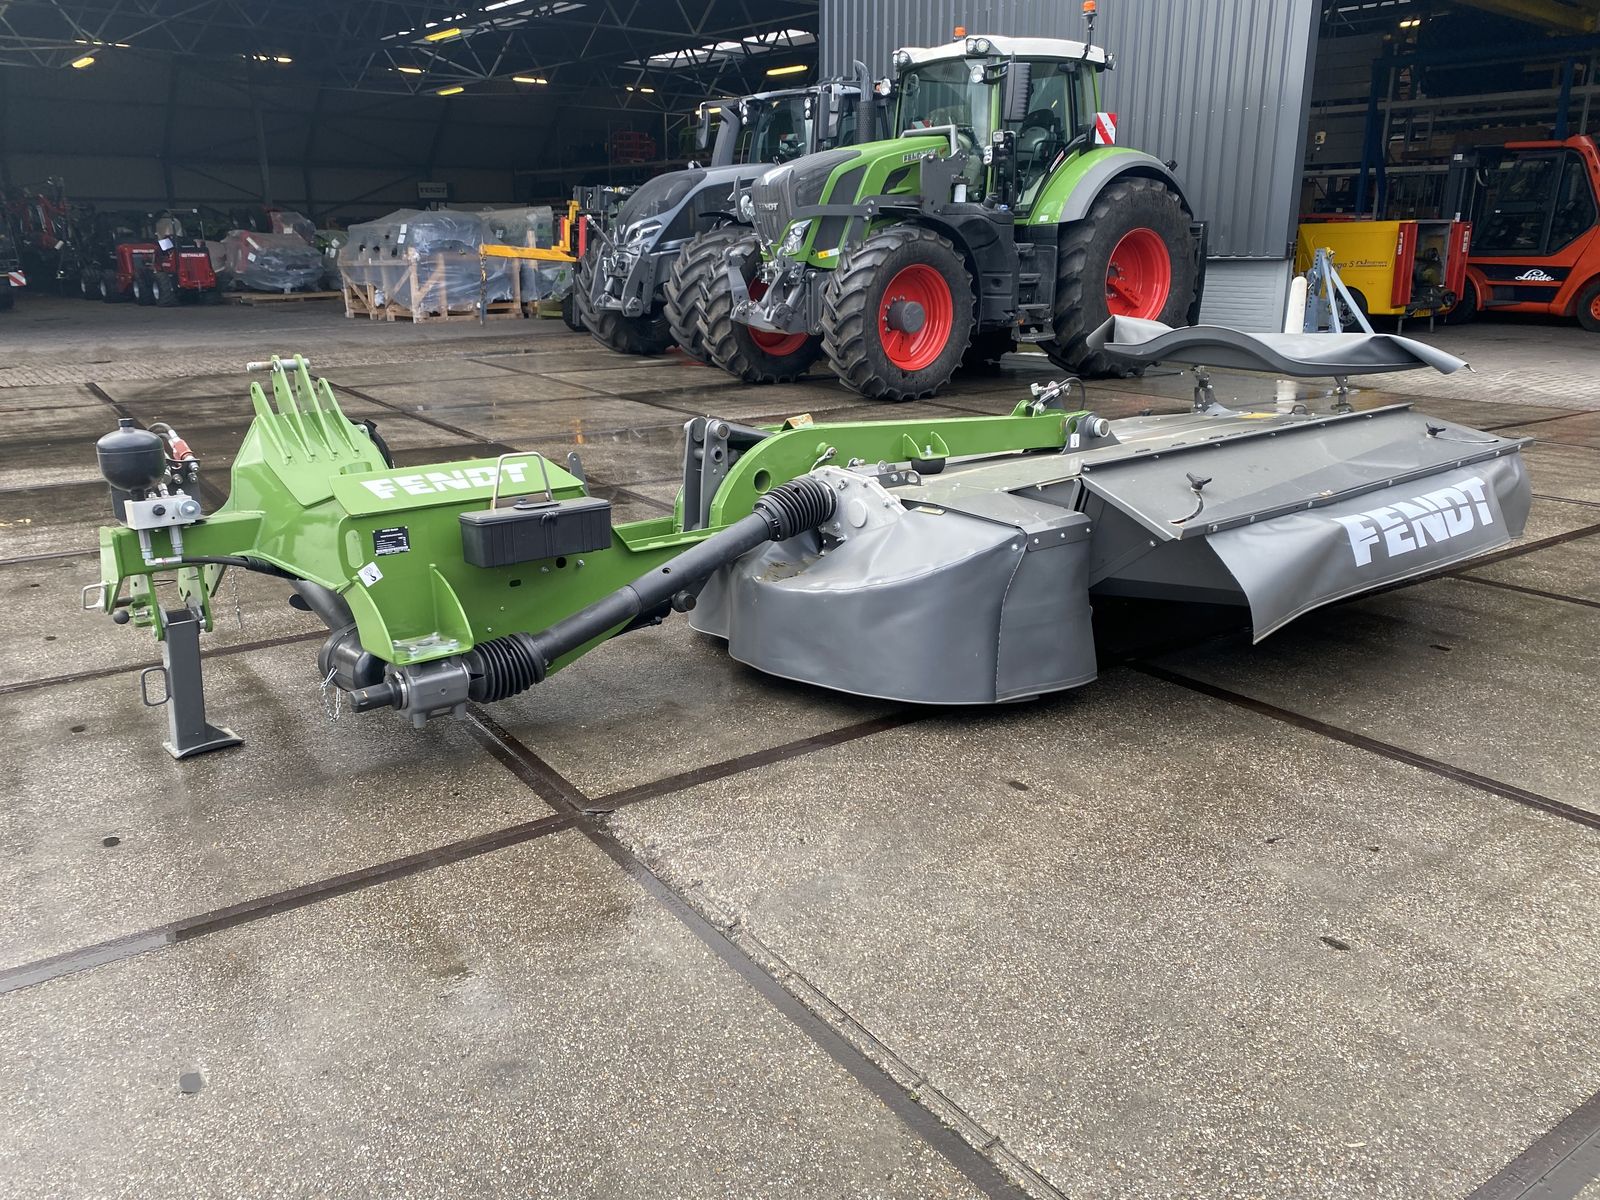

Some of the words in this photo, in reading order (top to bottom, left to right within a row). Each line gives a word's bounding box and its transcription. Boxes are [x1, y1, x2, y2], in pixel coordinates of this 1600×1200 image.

[1515, 269, 1554, 282] Linde
[360, 463, 527, 499] FENDT
[1330, 477, 1493, 567] FENDT
